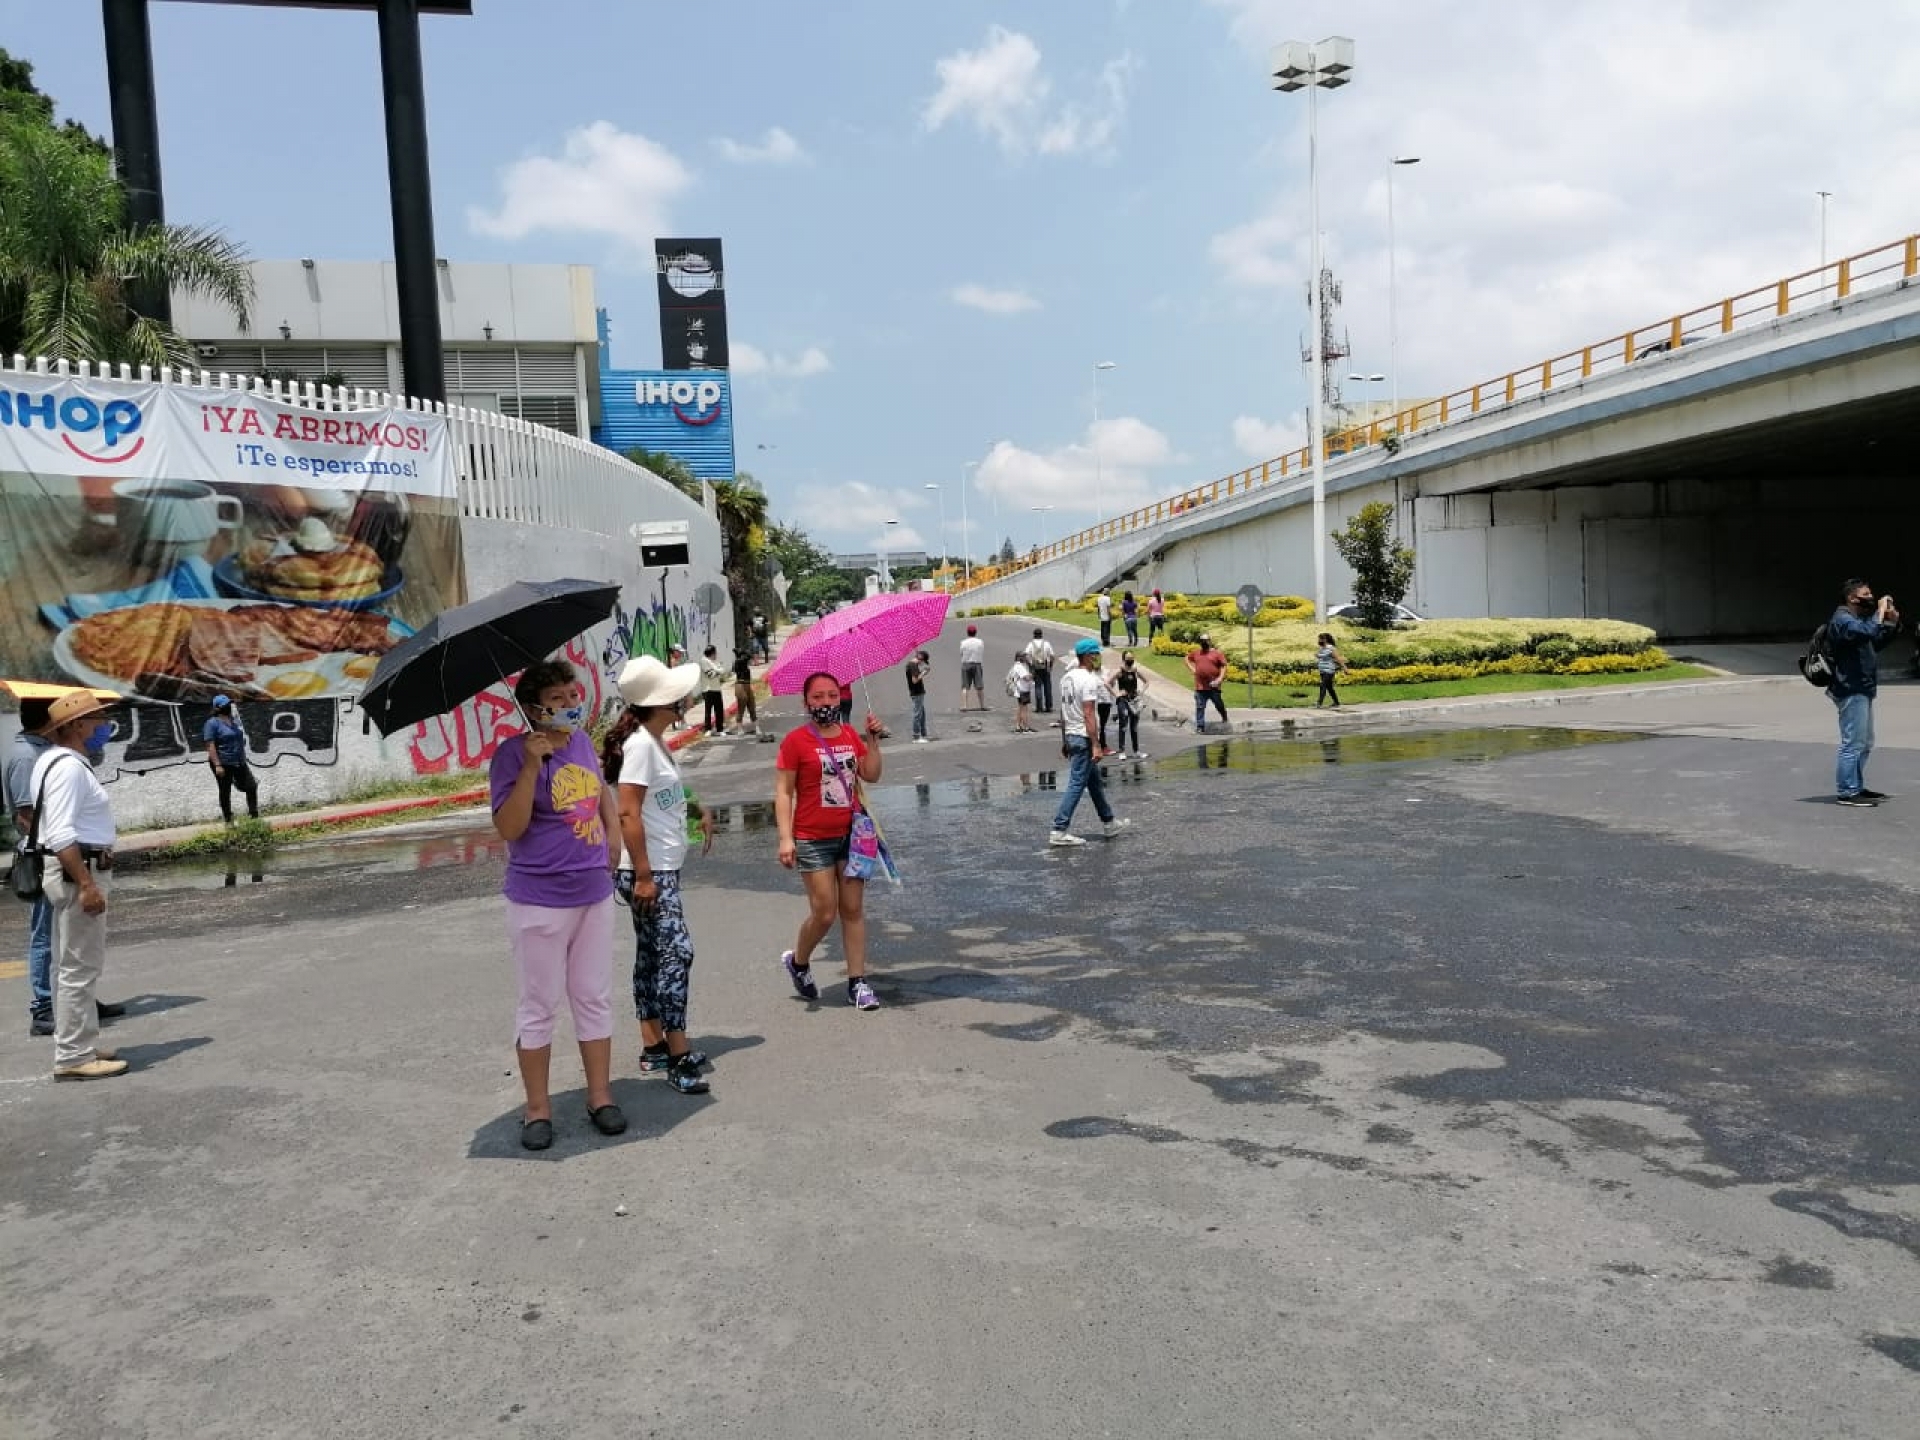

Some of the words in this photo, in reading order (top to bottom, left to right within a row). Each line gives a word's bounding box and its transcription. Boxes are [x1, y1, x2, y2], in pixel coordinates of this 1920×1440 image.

[201, 405, 265, 436] ¡YA
[273, 413, 429, 452] ABRIMOS!
[236, 444, 277, 466] ¡Te
[284, 454, 418, 478] esperamos!
